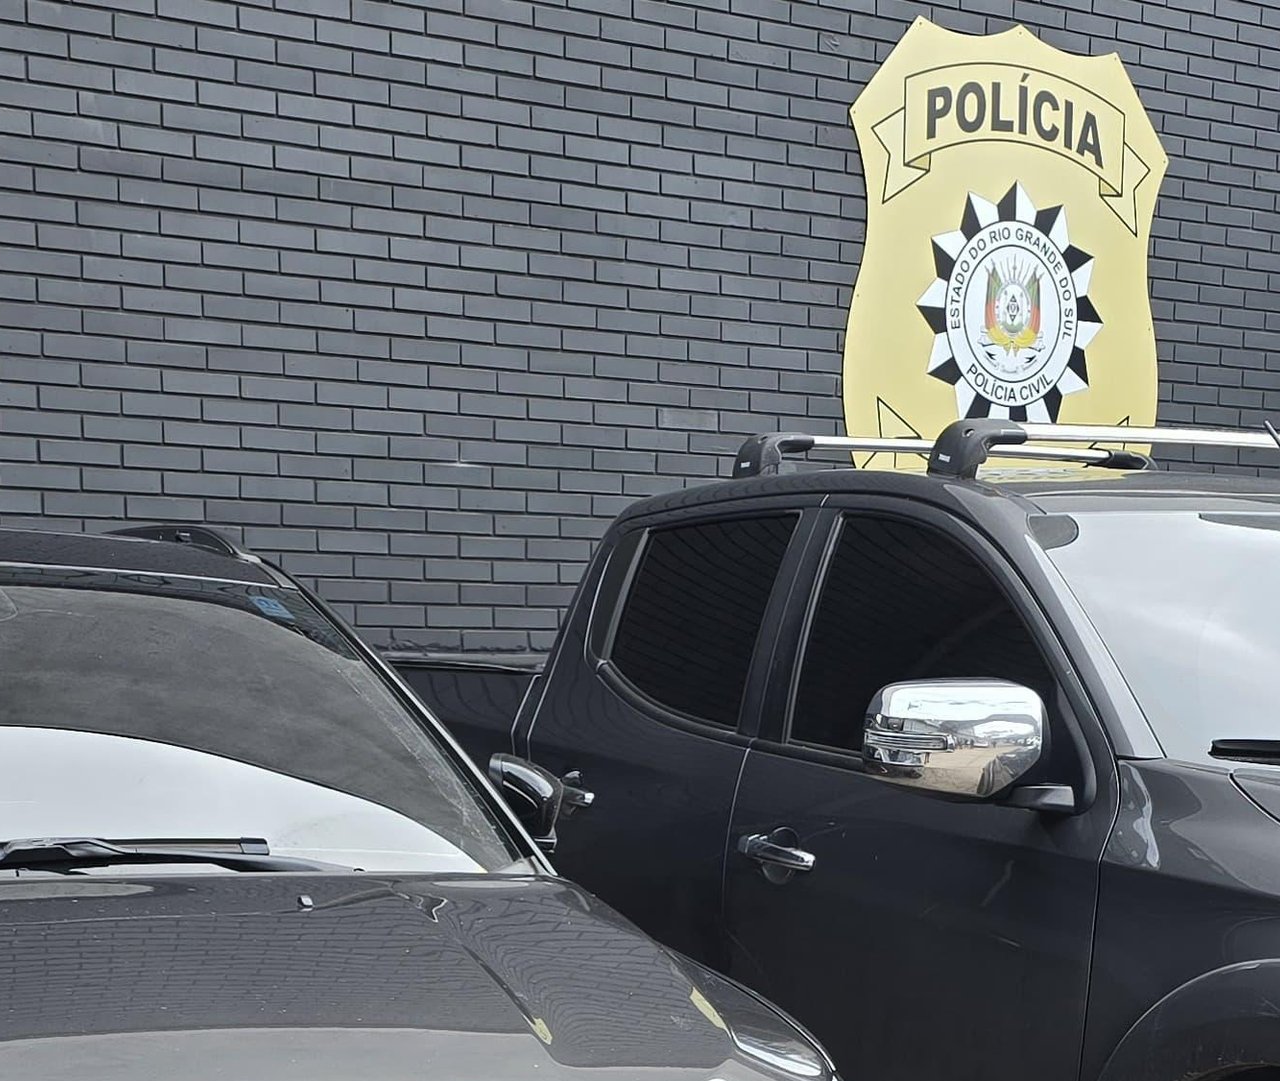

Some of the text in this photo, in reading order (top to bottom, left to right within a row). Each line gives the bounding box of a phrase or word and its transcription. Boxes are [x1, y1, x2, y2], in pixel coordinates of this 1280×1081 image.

[926, 73, 1104, 169] POLÍCIA
[949, 226, 1074, 341] ESTADO DO RIO GRANDE DO SUL
[966, 362, 1054, 402] POLÍCIA CIVIL
